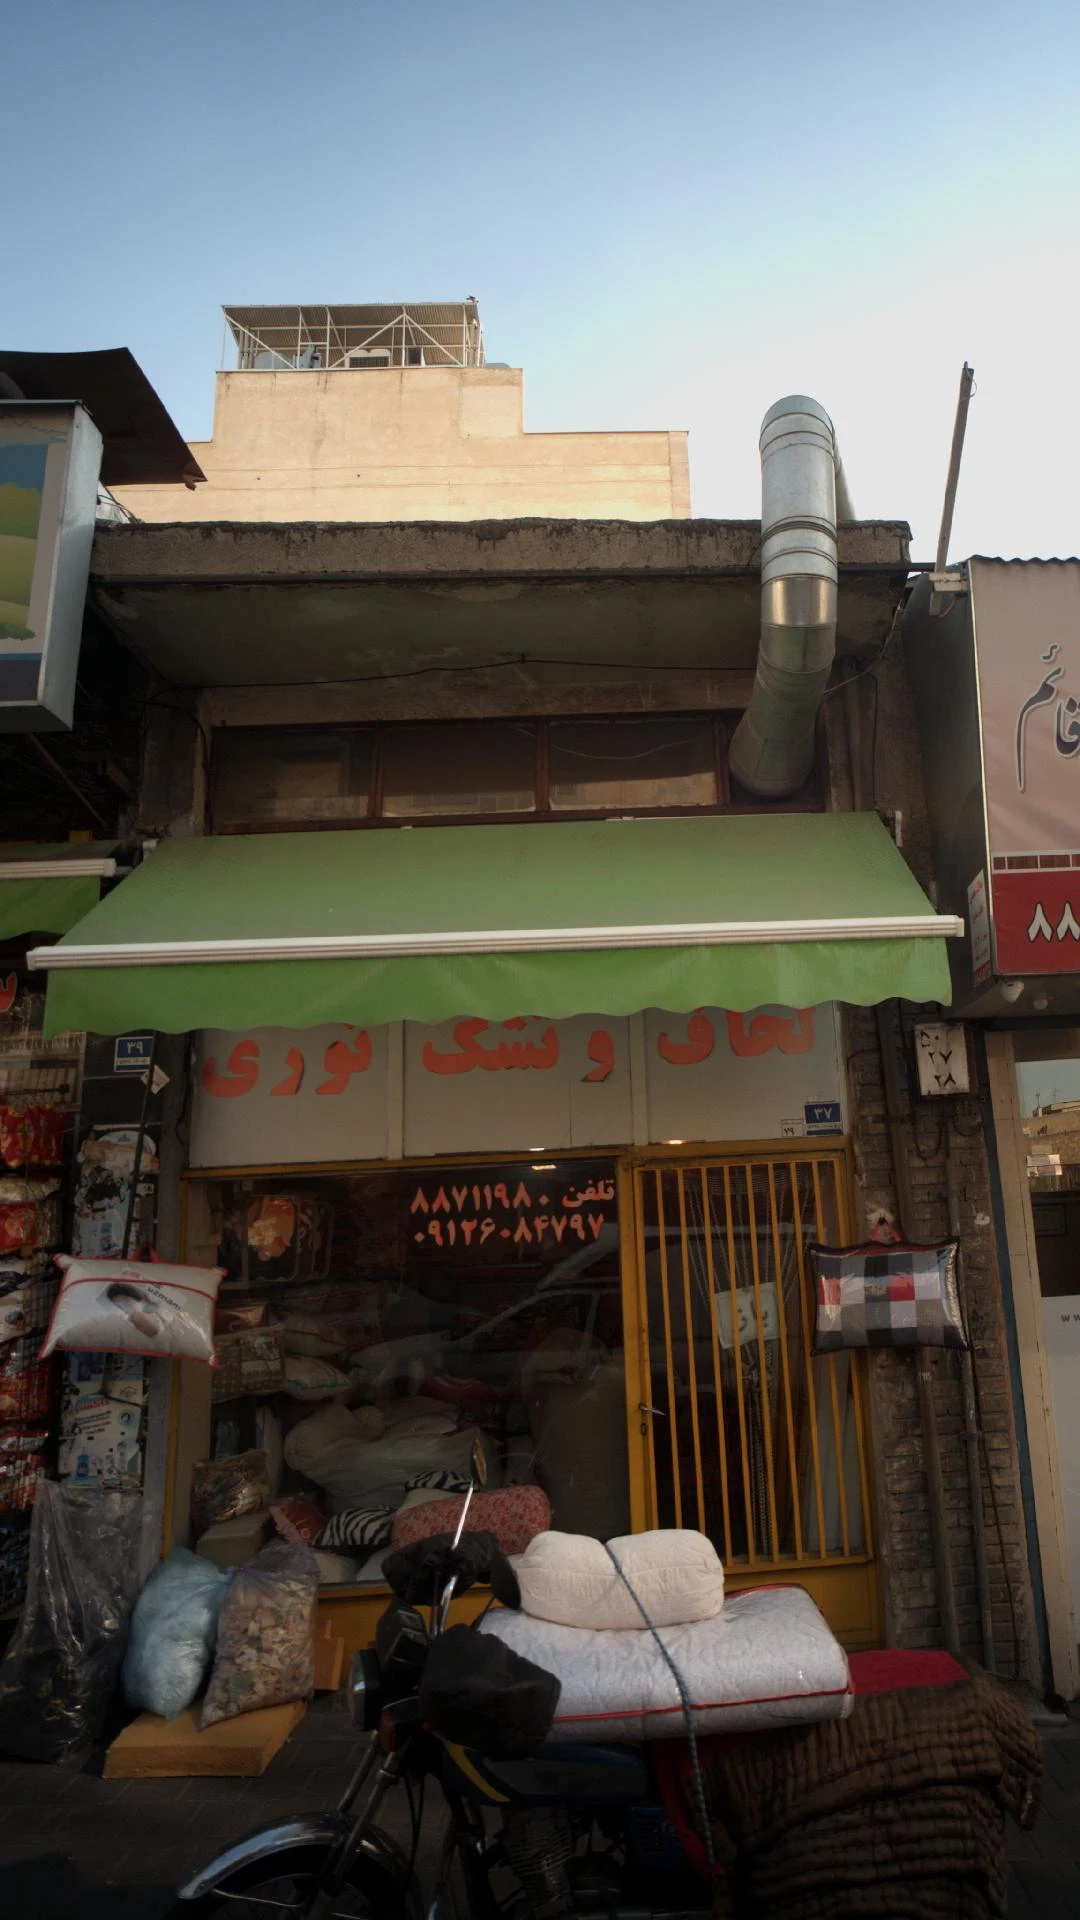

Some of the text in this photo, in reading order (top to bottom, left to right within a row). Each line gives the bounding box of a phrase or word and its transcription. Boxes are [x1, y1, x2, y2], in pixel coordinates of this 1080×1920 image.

[202, 1022, 373, 1098] نوری
[580, 1030, 616, 1083] و
[814, 1106, 833, 1120] ۳۷
[561, 1178, 616, 1208] تلفن
